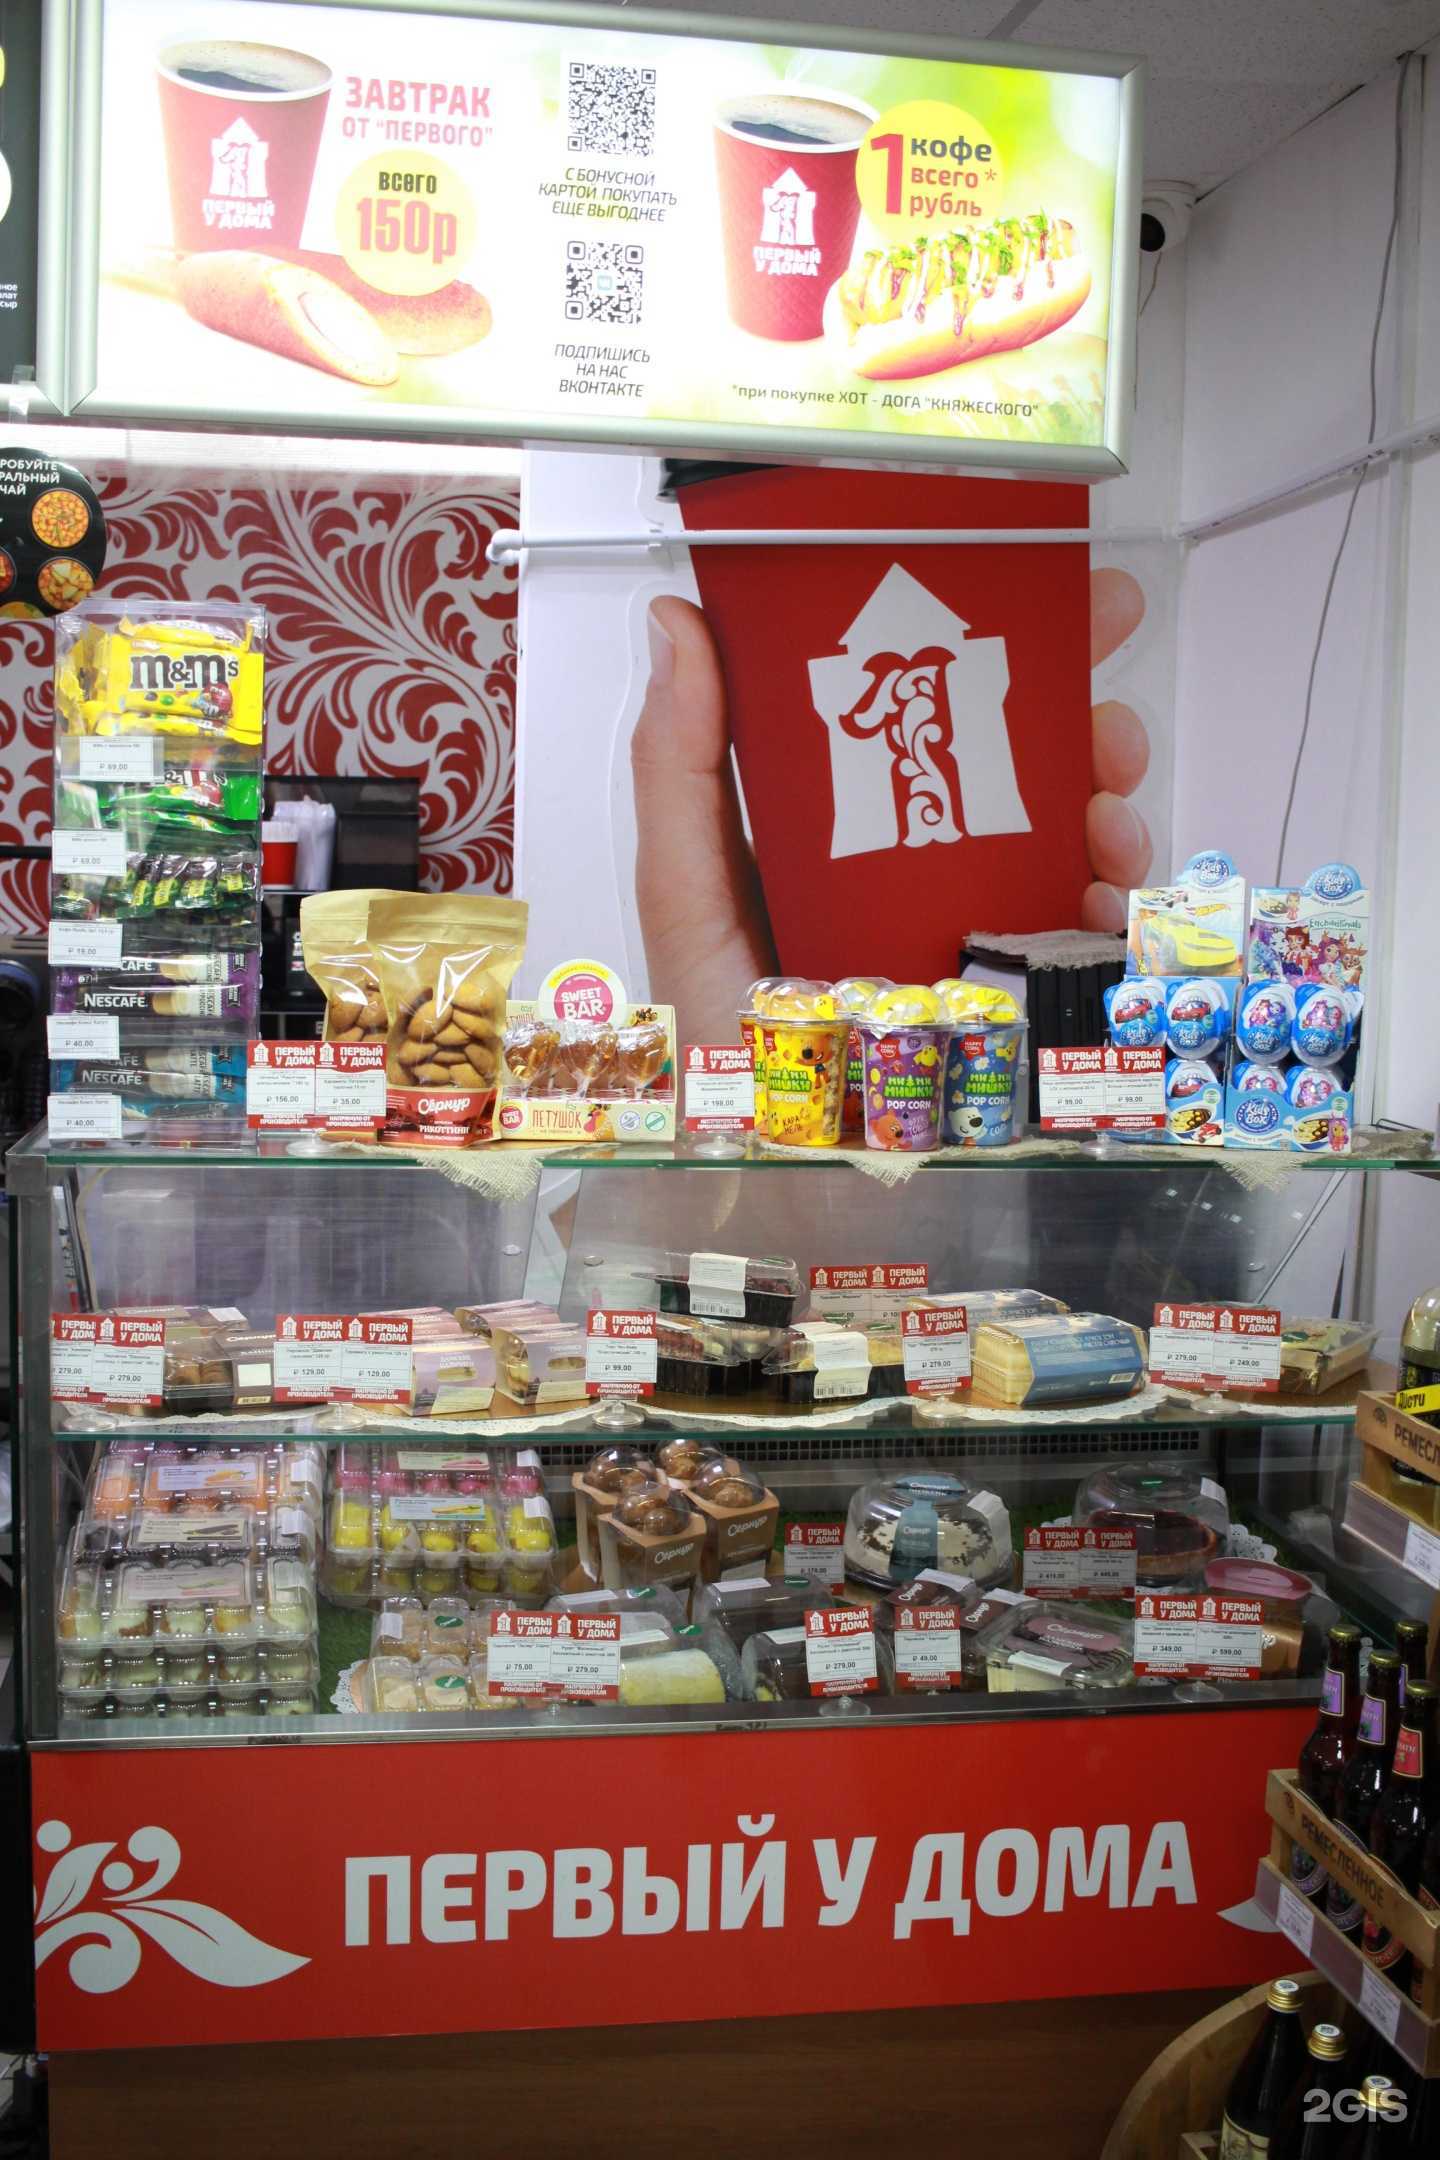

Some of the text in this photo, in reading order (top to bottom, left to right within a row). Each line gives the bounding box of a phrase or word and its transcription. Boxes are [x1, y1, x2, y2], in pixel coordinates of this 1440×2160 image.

[345, 76, 490, 117] ЗАВТРАК
[342, 117, 369, 138] ОТ
[910, 135, 992, 165] кофе
[565, 168, 655, 187] С БОНУСНОЙ
[870, 133, 904, 214] 1
[538, 182, 677, 206] КАРТОЙ ПОКУПАТЬ
[202, 198, 275, 216] ПЕРВЫЙ
[910, 193, 982, 218] рубль
[552, 202, 665, 222] ЕЩЕ ВЫГОДНЕЕ
[204, 213, 272, 229] У ДОМА
[357, 198, 457, 264] 150р
[753, 245, 821, 266] ПЕРВЫЙ
[754, 260, 819, 277] У ДОМА
[554, 344, 651, 363] ПОДПИШИСЬ
[576, 363, 628, 379] НА НАС
[559, 379, 644, 398] ВКОНТАКТЕ
[771, 388, 834, 406] покупке
[838, 391, 867, 405] ХОТ
[881, 394, 921, 410] ДОГА
[0, 459, 57, 471] РОБУЙТЕ
[0, 471, 60, 484] РАЛЬНЫЙ
[0, 483, 26, 495] ЧАЙ
[561, 987, 602, 1003] SWEET
[563, 999, 603, 1019] BAR
[275, 1045, 315, 1056] ПЕРВЫЙ
[340, 1045, 383, 1056] ПЕРВЫЙ
[710, 1048, 751, 1059] ПЕРВЫЙ
[1062, 1050, 1101, 1060] ПЕРВЫЙ
[1123, 1049, 1161, 1060] ПЕРВЫЙ
[275, 1056, 315, 1067] У ДОМА
[340, 1057, 382, 1067] У ДОМА
[710, 1059, 750, 1070] У ДОМА
[1063, 1061, 1101, 1071] У ДОМА
[1123, 1060, 1161, 1070] У ДОМА
[887, 1100, 931, 1109] POP CORN
[966, 1096, 985, 1105] POP
[532, 1110, 582, 1129] ПЕТУШОК
[612, 1314, 653, 1325] ПЕРВЫЙ
[925, 1308, 964, 1321] ПЕРВЫЙ
[1179, 1310, 1215, 1320] ПЕРВЫЙ
[1239, 1314, 1276, 1325] ПЕРВЫЙ
[120, 1321, 162, 1332] ПЕРВЫЙ
[303, 1319, 342, 1330] ПЕРВЫЙ
[369, 1322, 408, 1333] ПЕРВЫЙ
[926, 1320, 964, 1332] У ДОМА
[1180, 1320, 1214, 1329] У ДОМА
[1239, 1323, 1276, 1333] У ДОМА
[304, 1330, 342, 1340] У ДОМА
[613, 1325, 652, 1336] У ДОМА
[121, 1332, 161, 1343] У ДОМА
[369, 1333, 407, 1343] У ДОМА
[1160, 1600, 1197, 1610] ПЕРВЫЙ
[1221, 1602, 1261, 1612] ПЕРВЫЙ
[829, 1608, 869, 1621] ПЕРВЫЙ
[919, 1609, 955, 1620] ПЕРВЫЙ
[1160, 1610, 1196, 1619] У ДОМА
[1222, 1612, 1260, 1621] У ДОМА
[578, 1618, 616, 1629] ПЕРВЫЙ
[830, 1620, 869, 1633] У ДОМА
[920, 1619, 954, 1629] У ДОМА
[578, 1629, 615, 1638] У ДОМА
[345, 1813, 1197, 1947] ПЕРВЫЙ У ДОМА
